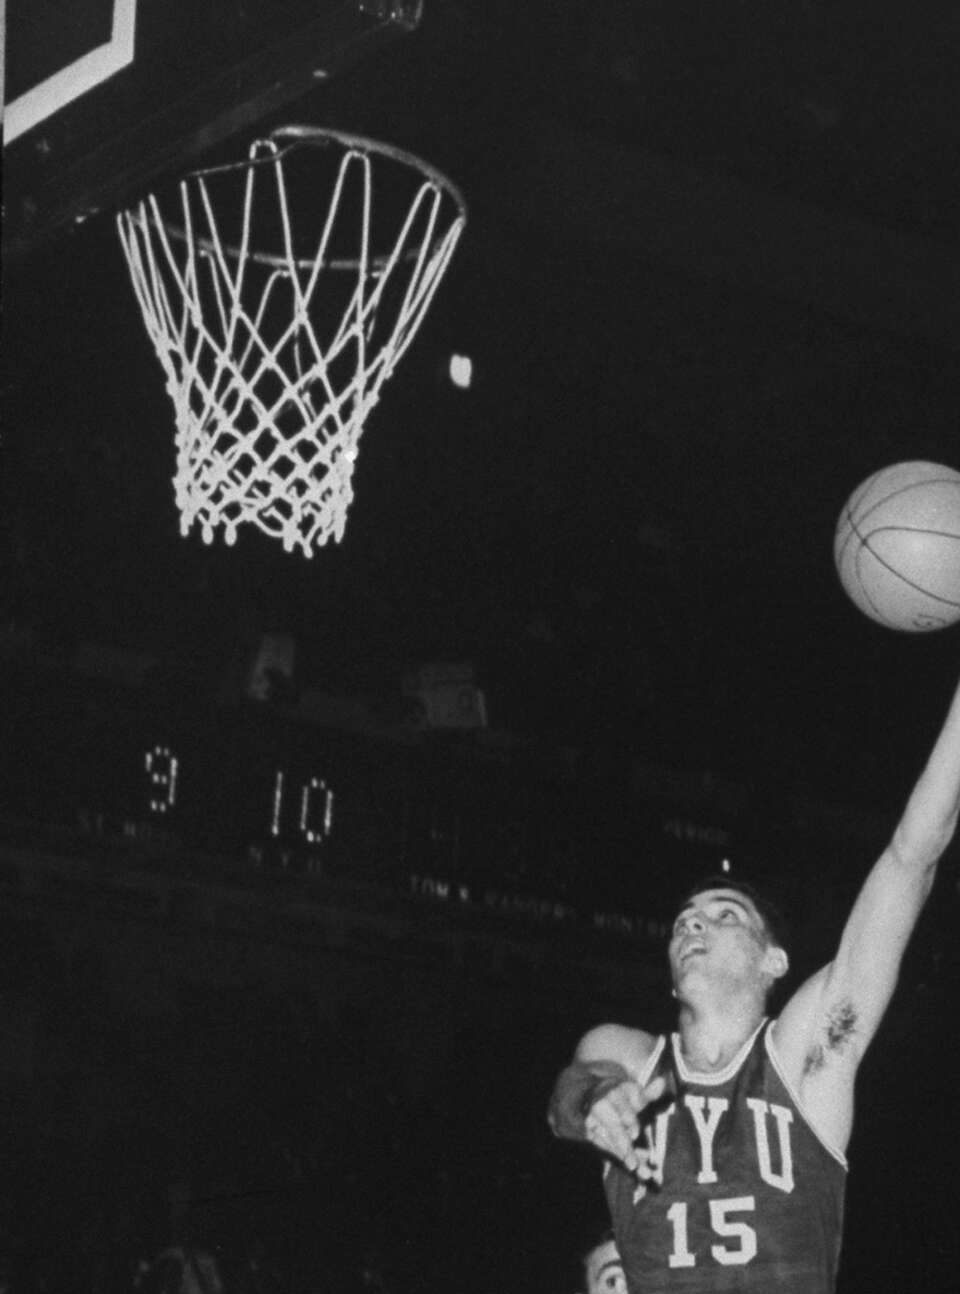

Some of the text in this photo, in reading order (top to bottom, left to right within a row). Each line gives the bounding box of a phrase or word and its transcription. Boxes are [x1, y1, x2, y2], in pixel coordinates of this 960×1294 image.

[145, 746, 334, 842] 9 10
[666, 1196, 757, 1268] 15
